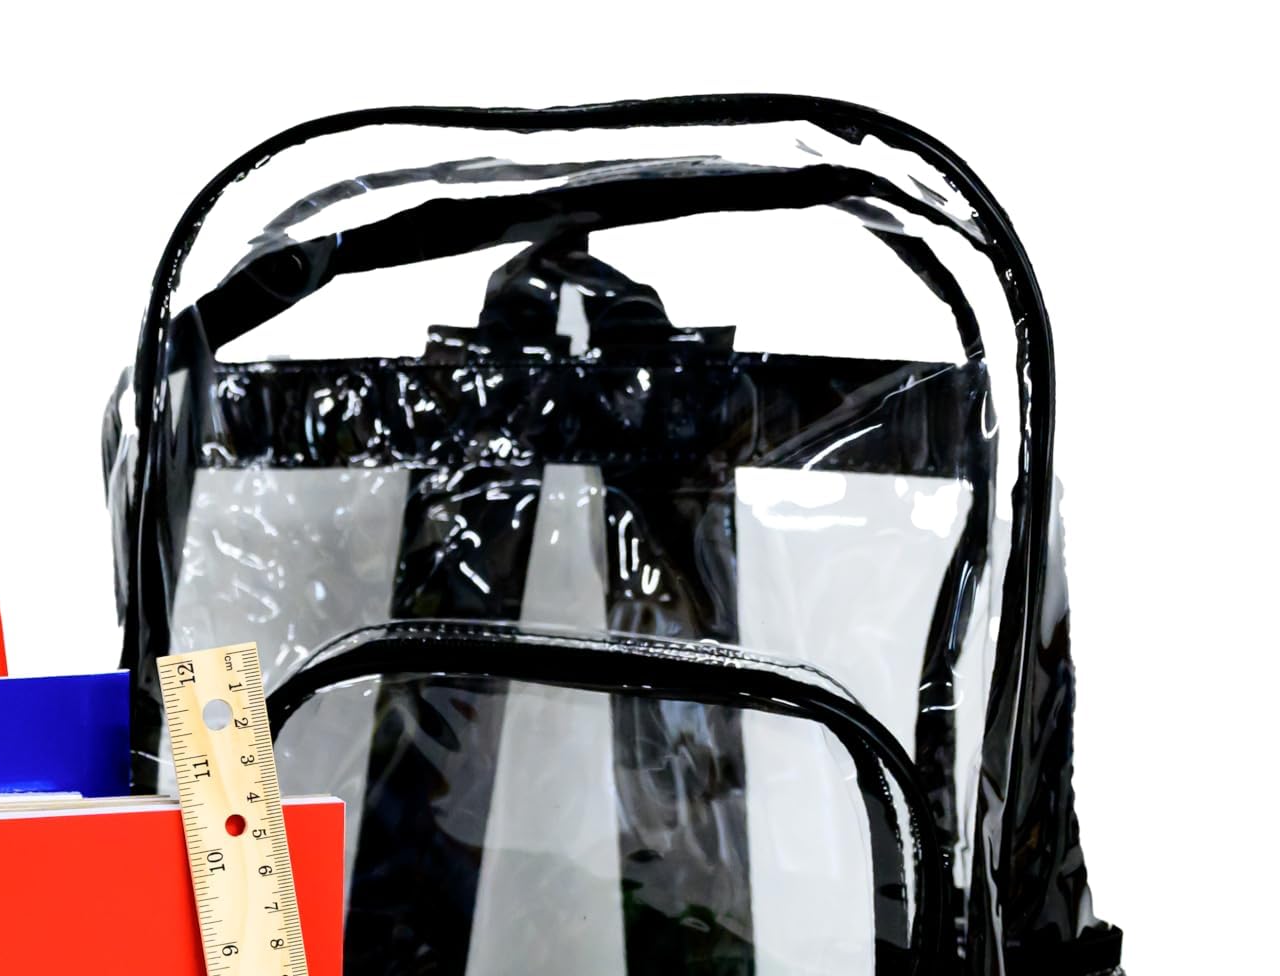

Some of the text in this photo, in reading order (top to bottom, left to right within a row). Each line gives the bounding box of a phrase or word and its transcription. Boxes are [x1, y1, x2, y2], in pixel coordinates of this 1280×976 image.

[224, 656, 233, 671] cm
[177, 663, 196, 685] 12
[228, 682, 243, 691] 1
[234, 717, 249, 728] 2
[241, 755, 255, 765] 3
[193, 759, 210, 779] 11
[247, 792, 260, 802] 4
[252, 829, 267, 838] 5
[207, 851, 225, 873] 10
[258, 865, 273, 875] 6
[270, 938, 285, 948] 8
